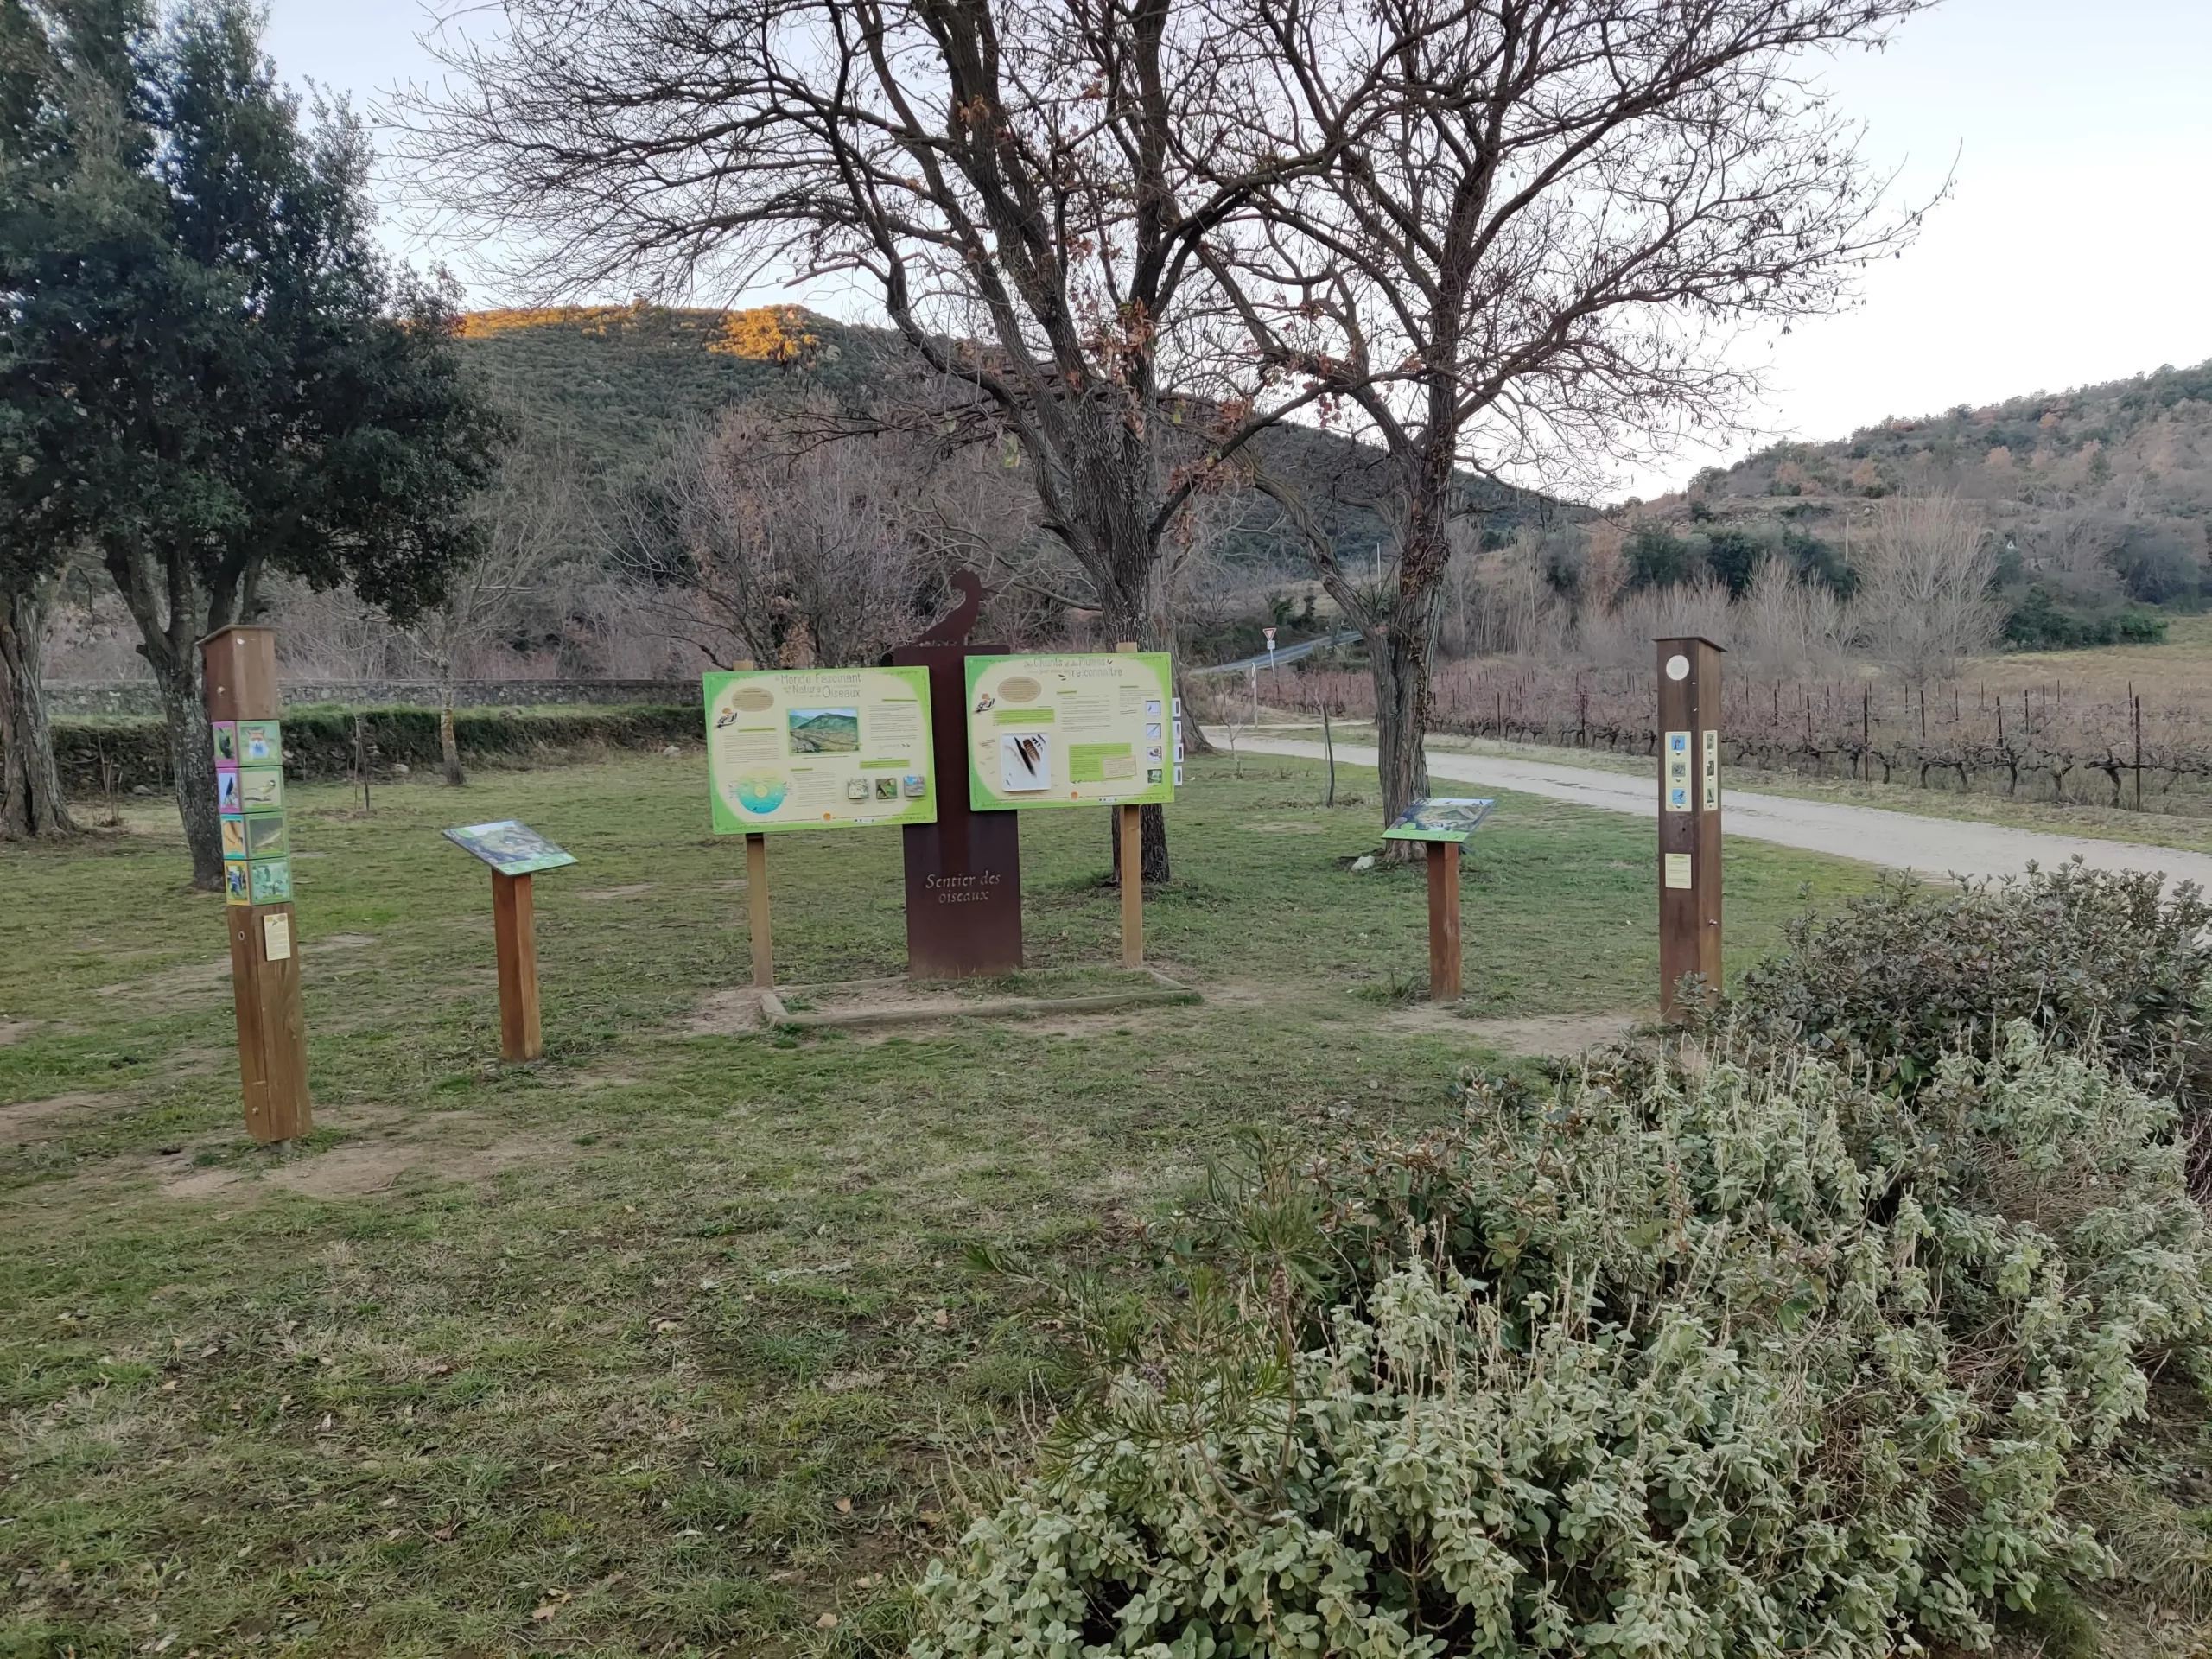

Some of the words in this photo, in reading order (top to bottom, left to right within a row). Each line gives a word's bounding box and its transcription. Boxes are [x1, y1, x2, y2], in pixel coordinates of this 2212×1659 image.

[1033, 657, 1063, 668] Chants
[780, 674, 811, 685] Monde
[815, 672, 861, 683] Fascinant
[792, 684, 822, 694] Nature
[823, 685, 861, 698] Oiseaux
[925, 873, 976, 889] Sentier
[980, 869, 1001, 886] des
[938, 889, 990, 904] oiseaux
